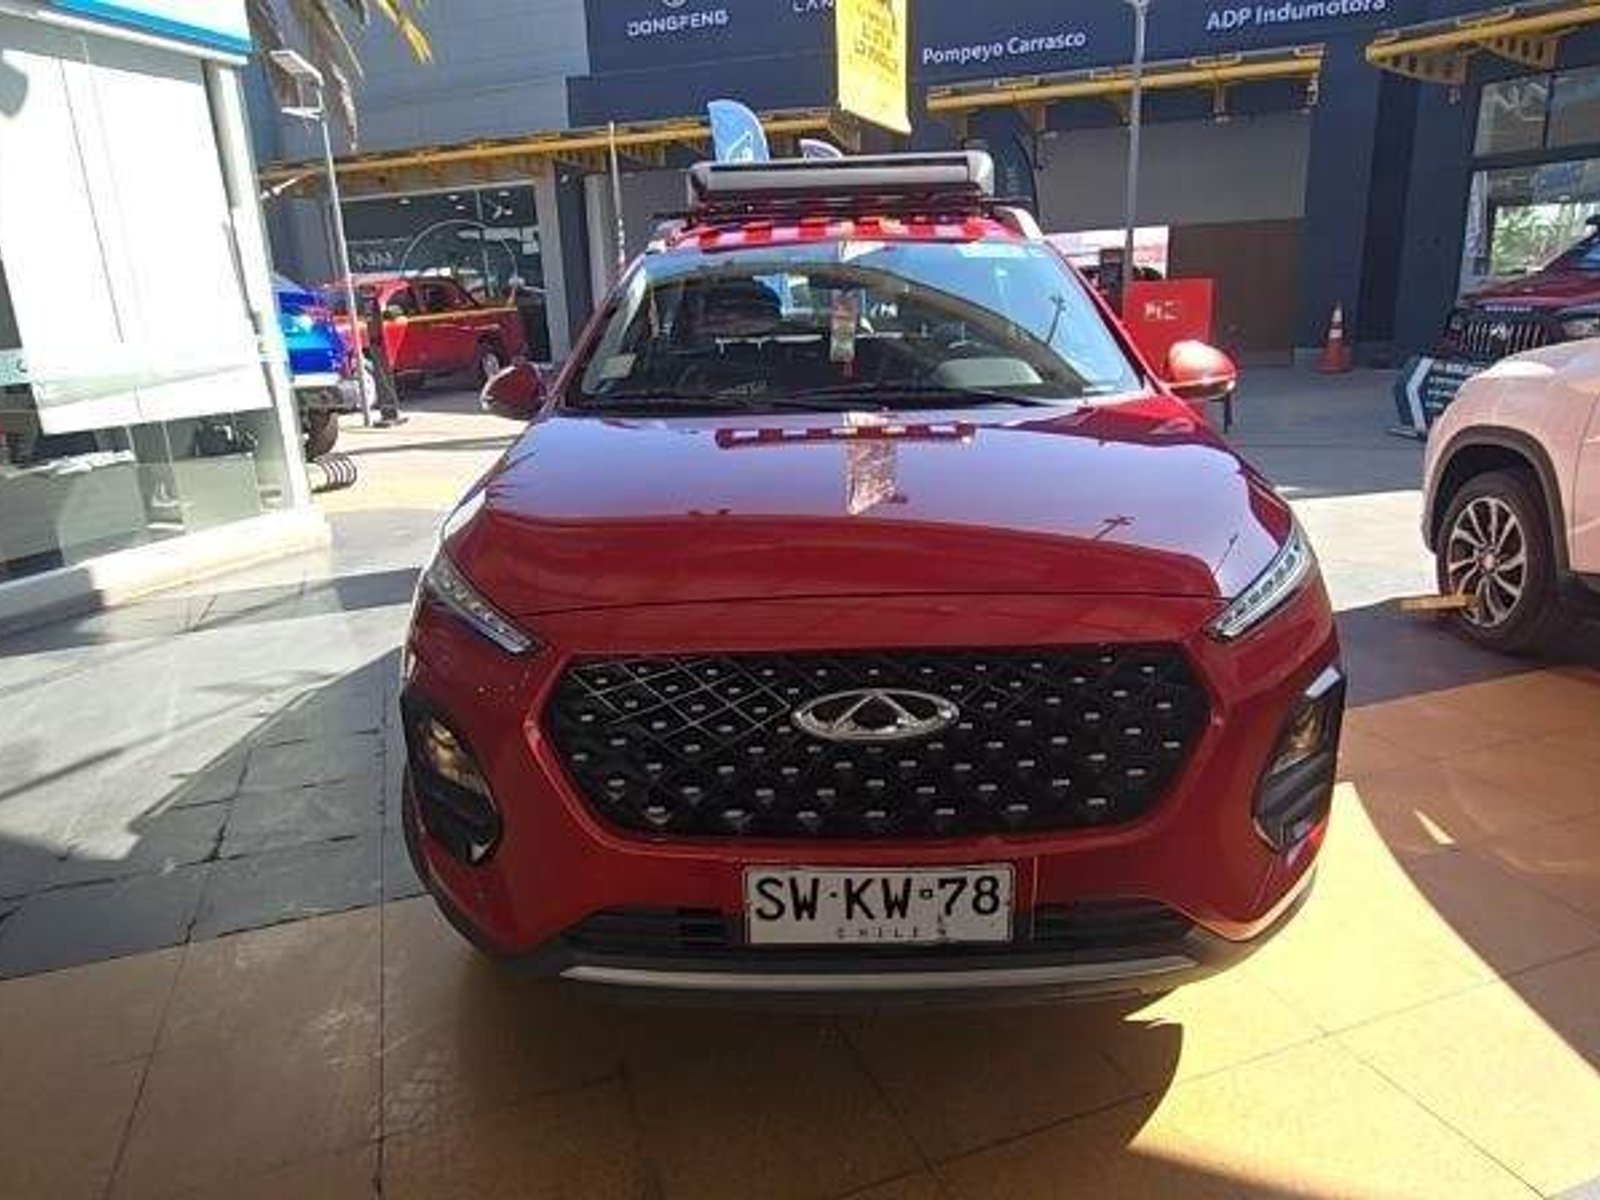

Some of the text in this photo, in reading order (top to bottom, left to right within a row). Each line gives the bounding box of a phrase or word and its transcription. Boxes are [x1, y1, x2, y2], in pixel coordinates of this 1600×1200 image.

[626, 9, 730, 36] DONGFENG
[1206, 0, 1387, 31] ADP Indumotora
[923, 32, 1087, 65] Pompeyo Carrasco
